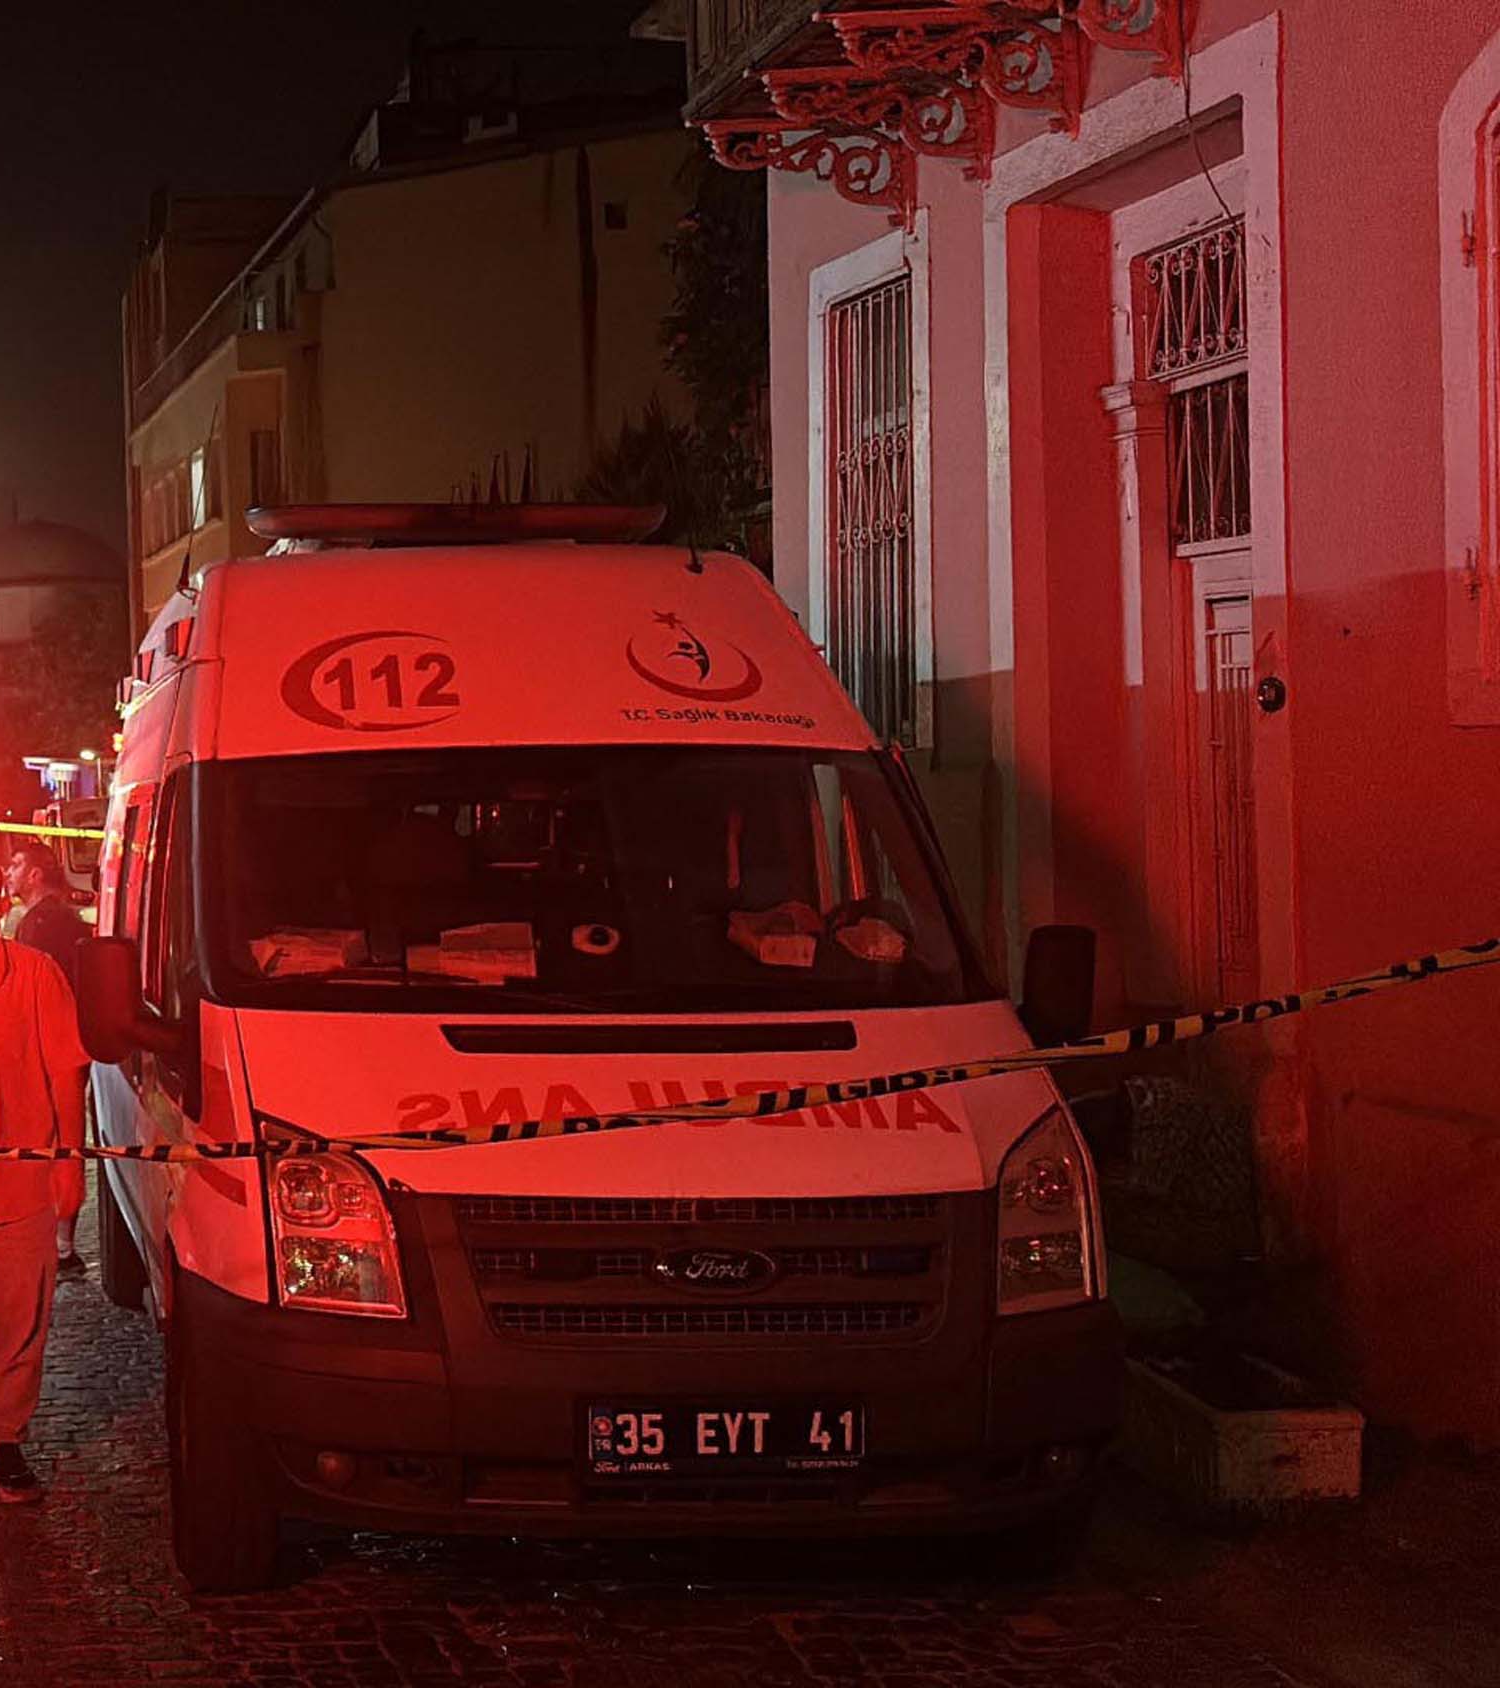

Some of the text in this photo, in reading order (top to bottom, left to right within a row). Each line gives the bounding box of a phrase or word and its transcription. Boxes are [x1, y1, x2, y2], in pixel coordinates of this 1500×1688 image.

[323, 652, 460, 711] 112
[684, 1251, 749, 1279] Ford
[615, 1412, 664, 1455] 35
[696, 1411, 771, 1455] EYT
[809, 1410, 854, 1452] 41
